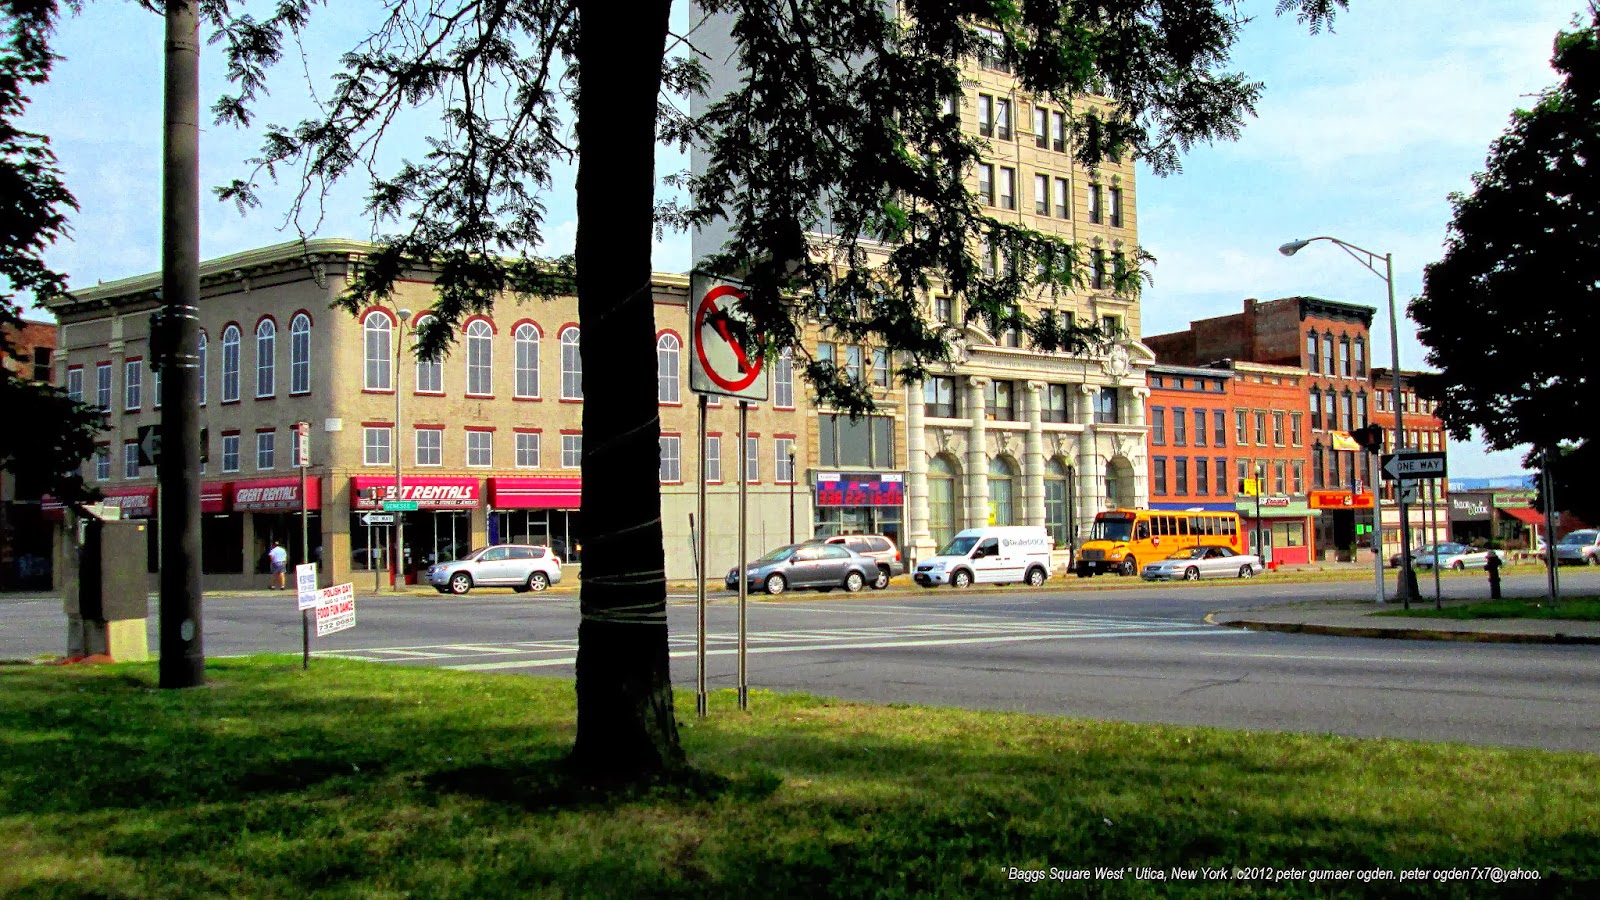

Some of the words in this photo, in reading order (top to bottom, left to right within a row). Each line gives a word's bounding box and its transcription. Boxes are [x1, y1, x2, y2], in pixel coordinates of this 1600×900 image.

[1396, 461, 1415, 471] ONE
[1420, 460, 1440, 469] WAY
[236, 487, 264, 502] GREAT
[262, 486, 298, 501] RENTALS
[411, 485, 473, 499] RENTALS
[323, 586, 341, 598] POLISH
[341, 584, 352, 594] DAY
[317, 606, 330, 619] FOOD
[330, 604, 339, 616] FUN
[339, 600, 354, 613] DANCE
